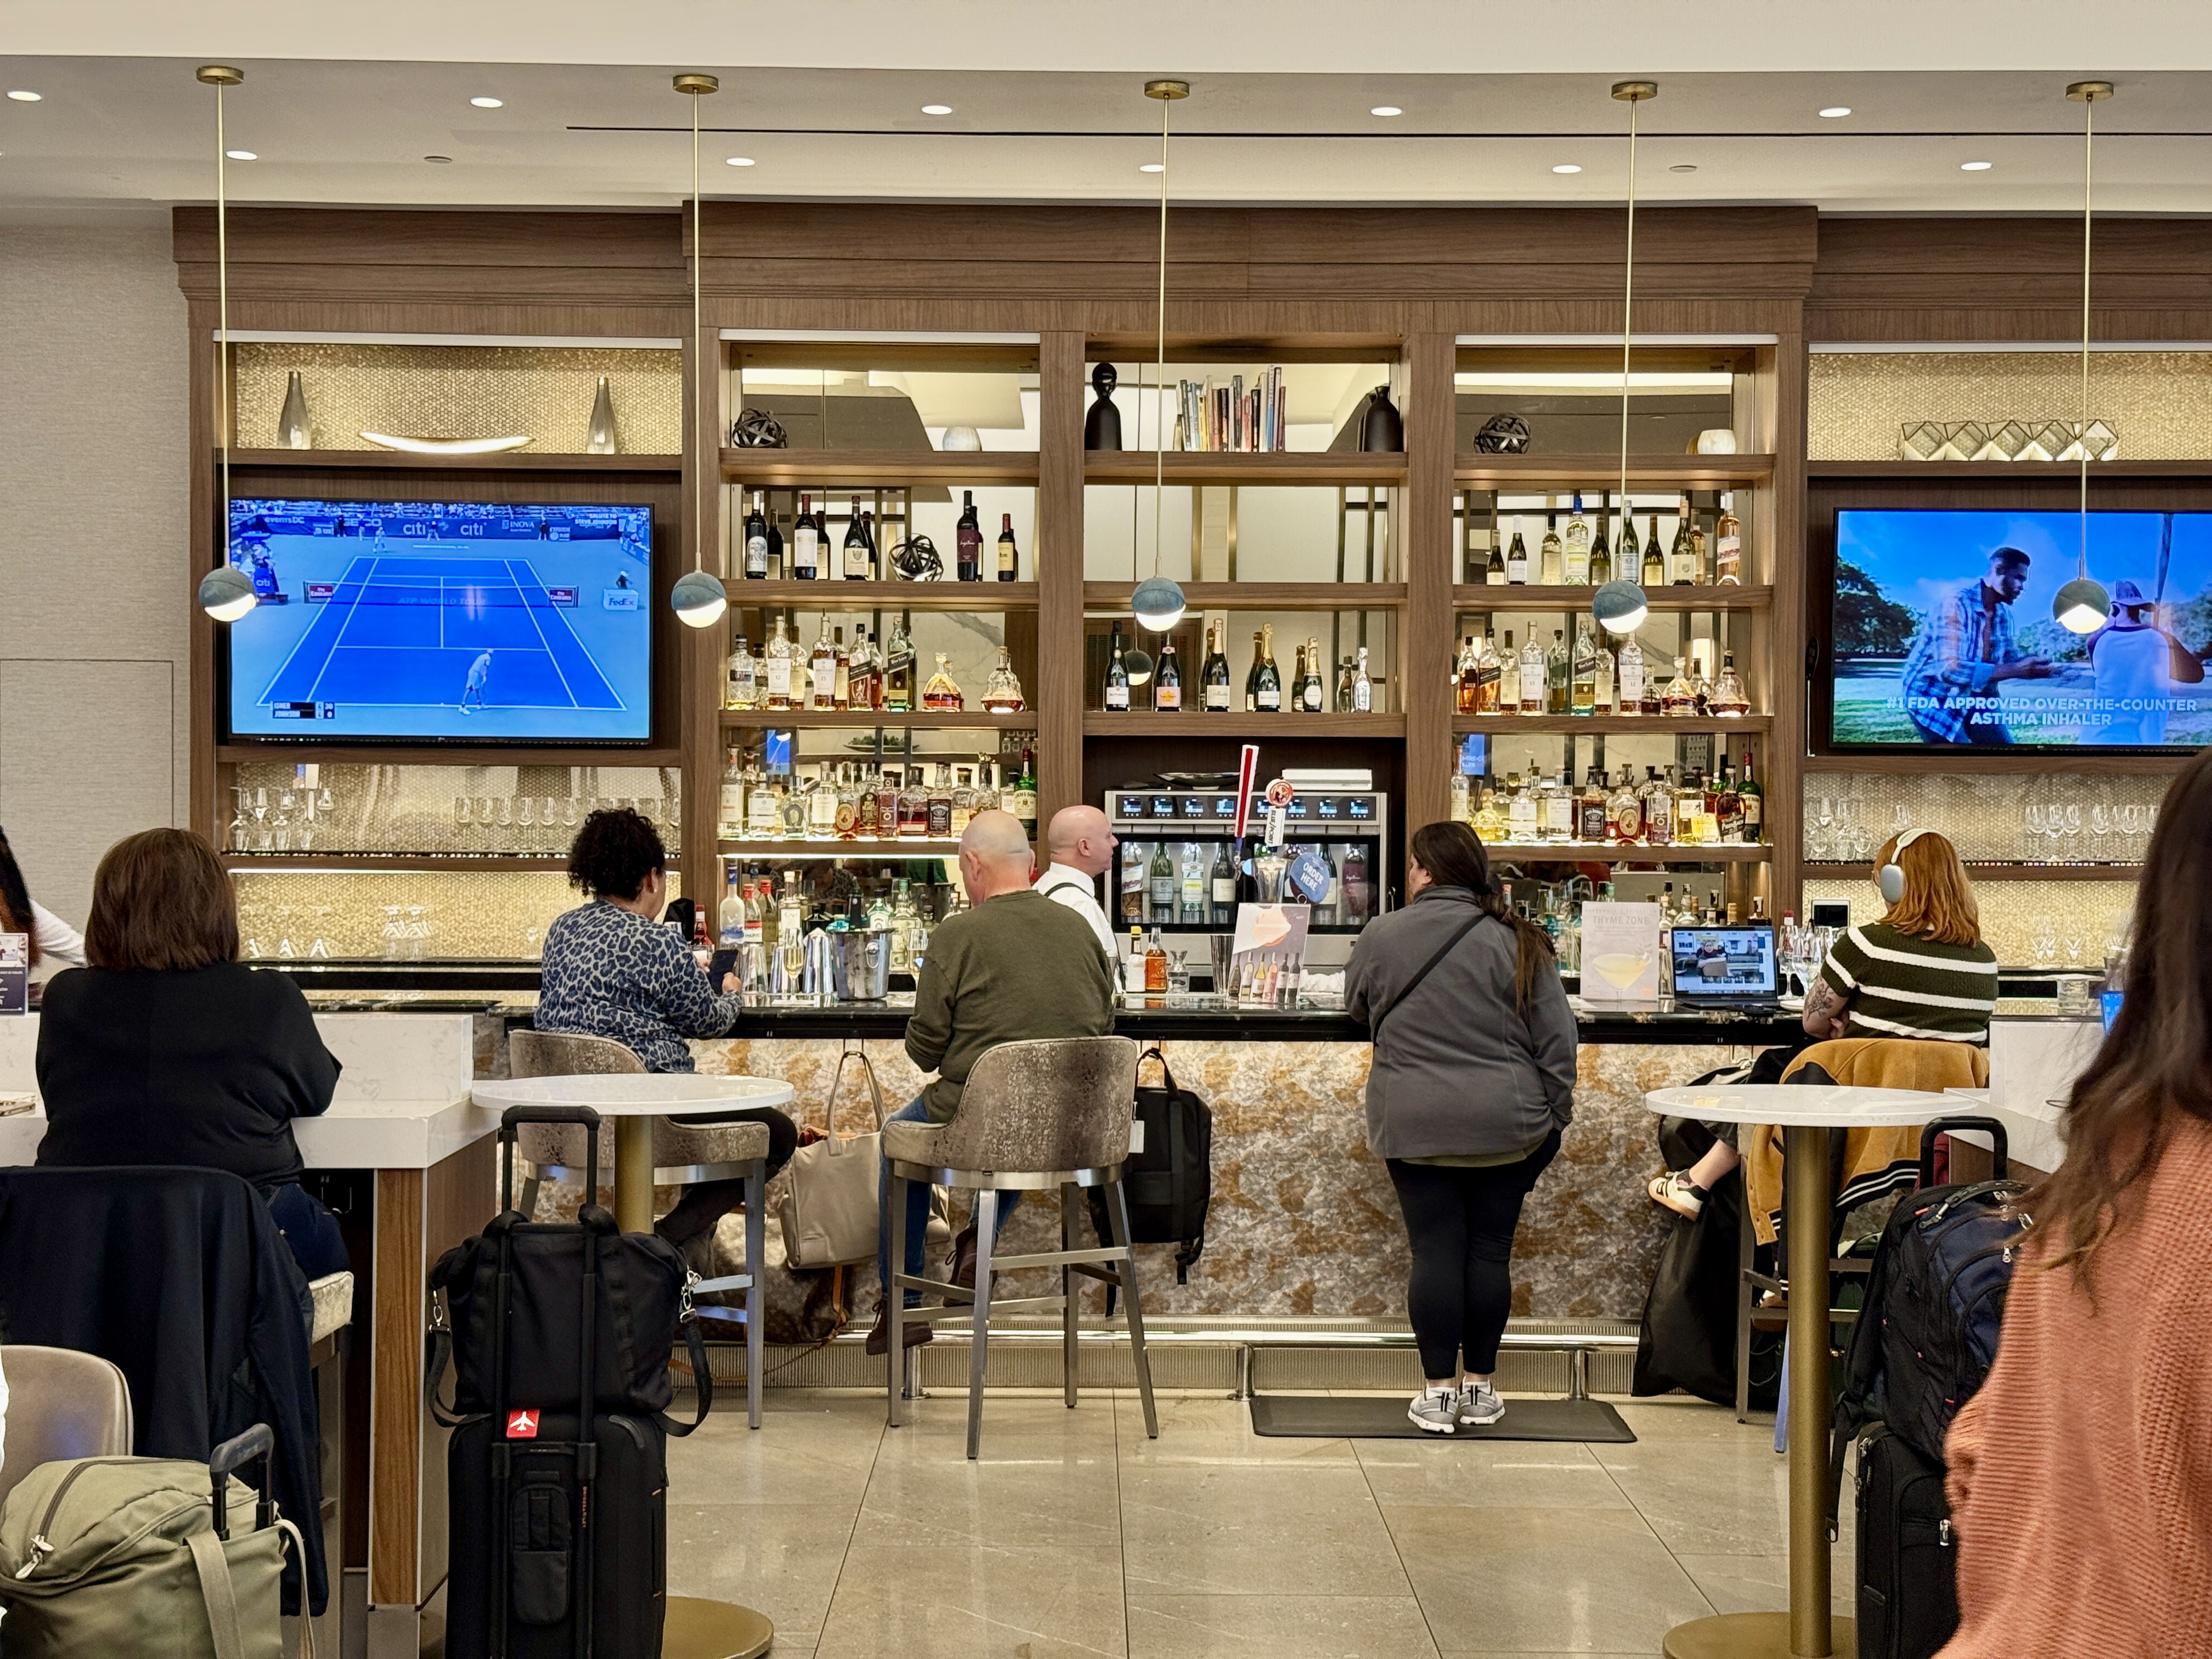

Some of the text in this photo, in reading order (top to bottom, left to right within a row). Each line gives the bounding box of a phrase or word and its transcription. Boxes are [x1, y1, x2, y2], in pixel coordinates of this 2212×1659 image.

[403, 522, 426, 535] citi
[460, 522, 483, 536] citi
[609, 597, 635, 606] FedEx
[1887, 697, 2197, 712] #1 FDA APPROVED OVER-THE-COUNTER
[1970, 713, 2112, 726] ASTHMA INHALER
[1303, 862, 1324, 885] ORDER
[1300, 871, 1318, 892] HERE
[1593, 915, 1650, 925] THYME ZONE
